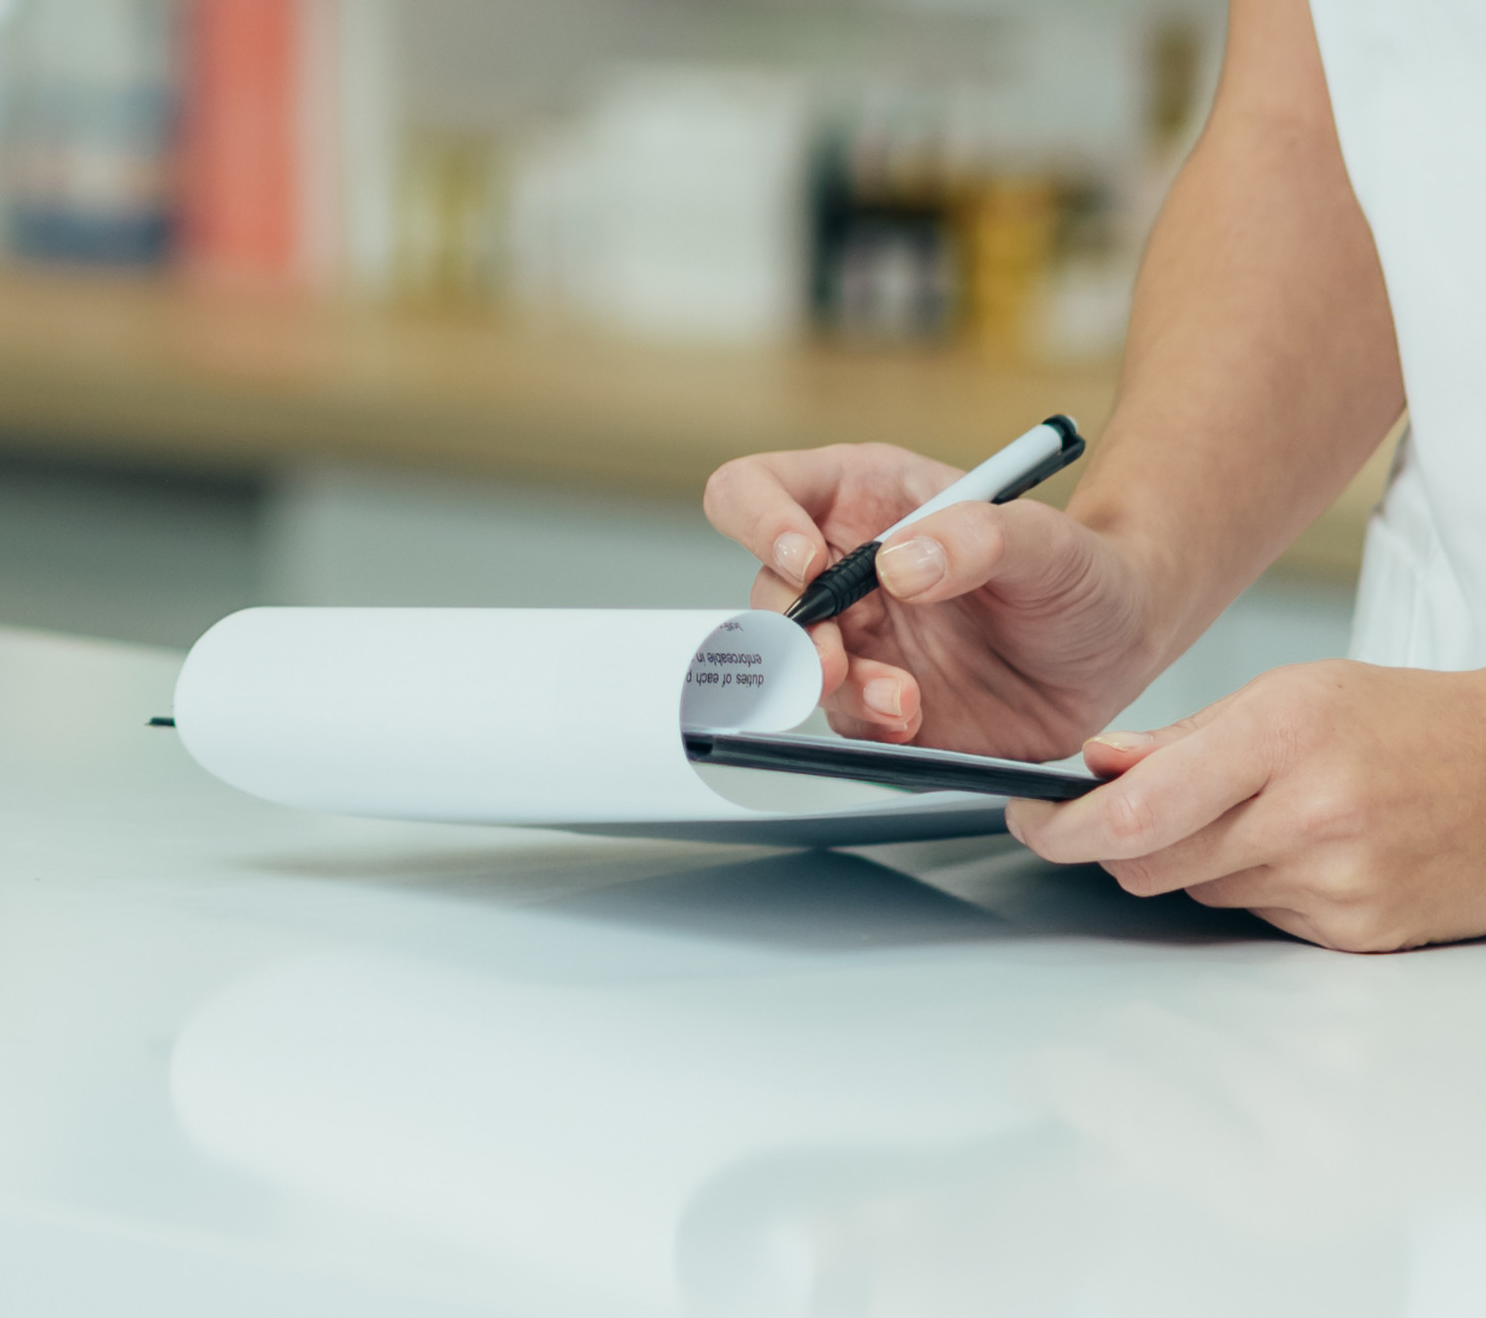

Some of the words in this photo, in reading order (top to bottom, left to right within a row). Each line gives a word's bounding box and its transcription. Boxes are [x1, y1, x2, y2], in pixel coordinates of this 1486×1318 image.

[696, 652, 706, 666] in
[707, 652, 762, 667] enforceable
[696, 672, 719, 685] each
[721, 673, 732, 688] of
[736, 673, 764, 688] duties
